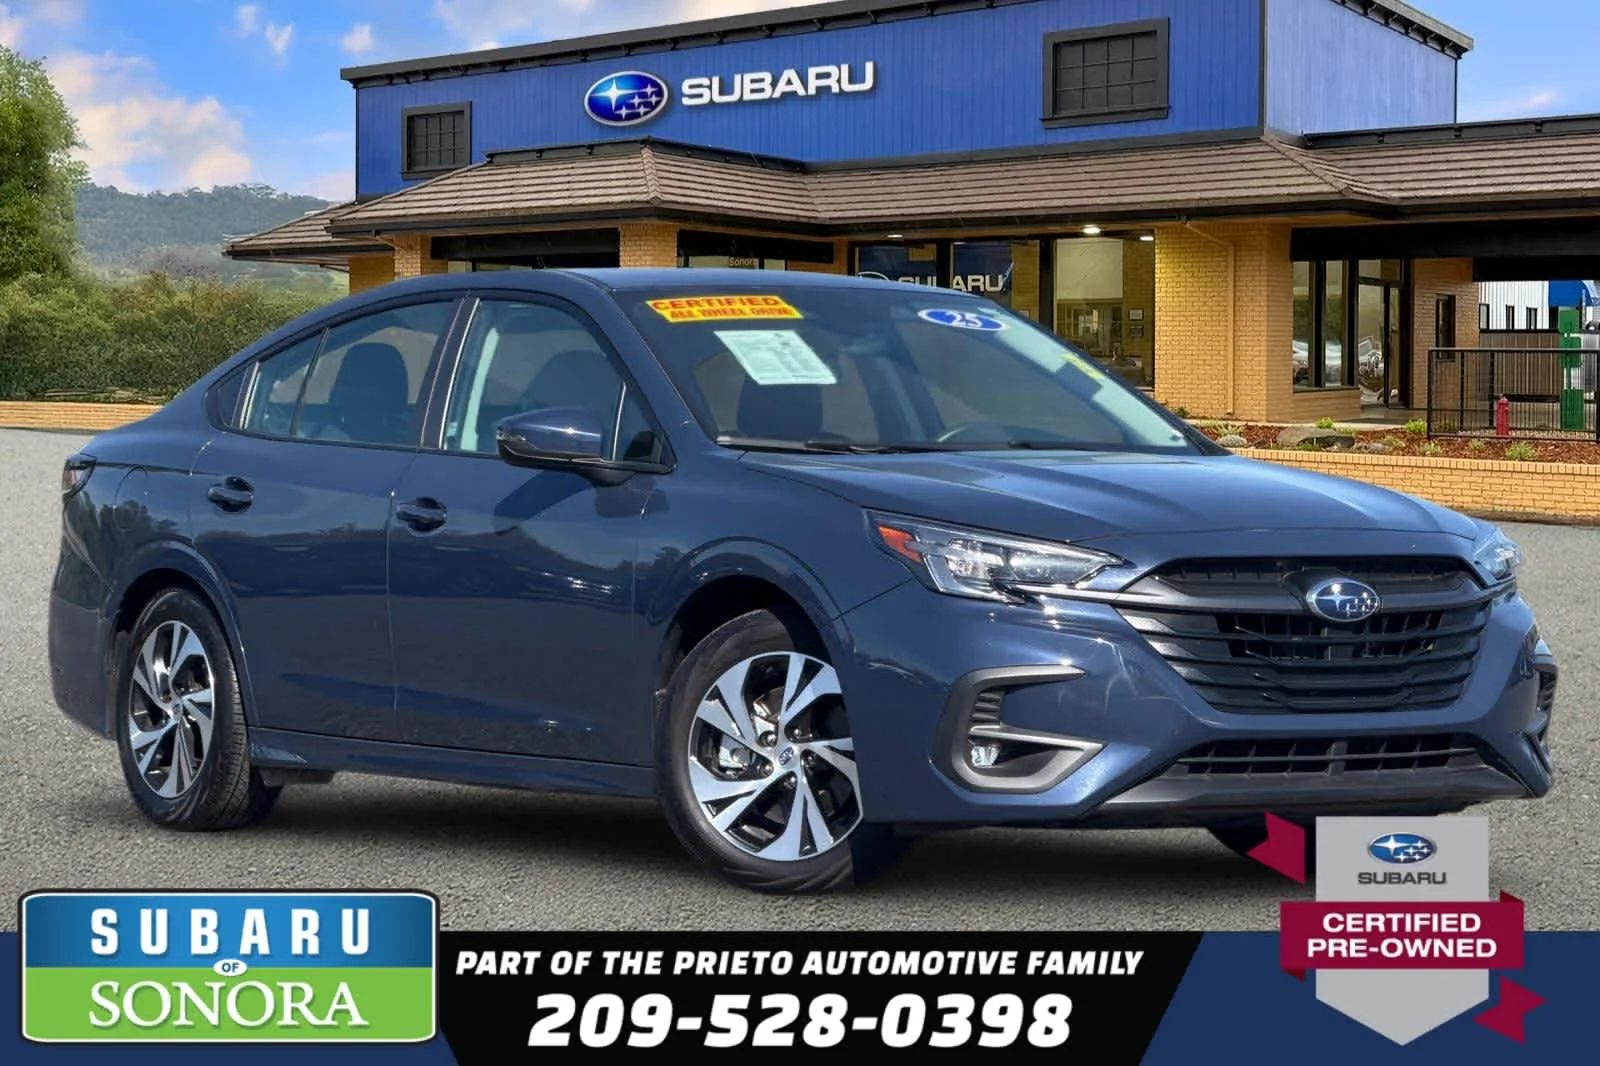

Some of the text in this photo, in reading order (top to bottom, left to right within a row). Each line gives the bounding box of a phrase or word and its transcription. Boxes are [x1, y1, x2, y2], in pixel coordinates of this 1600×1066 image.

[681, 61, 875, 106] SUBARU
[652, 296, 780, 311] CERTIFIED
[945, 311, 982, 329] 25
